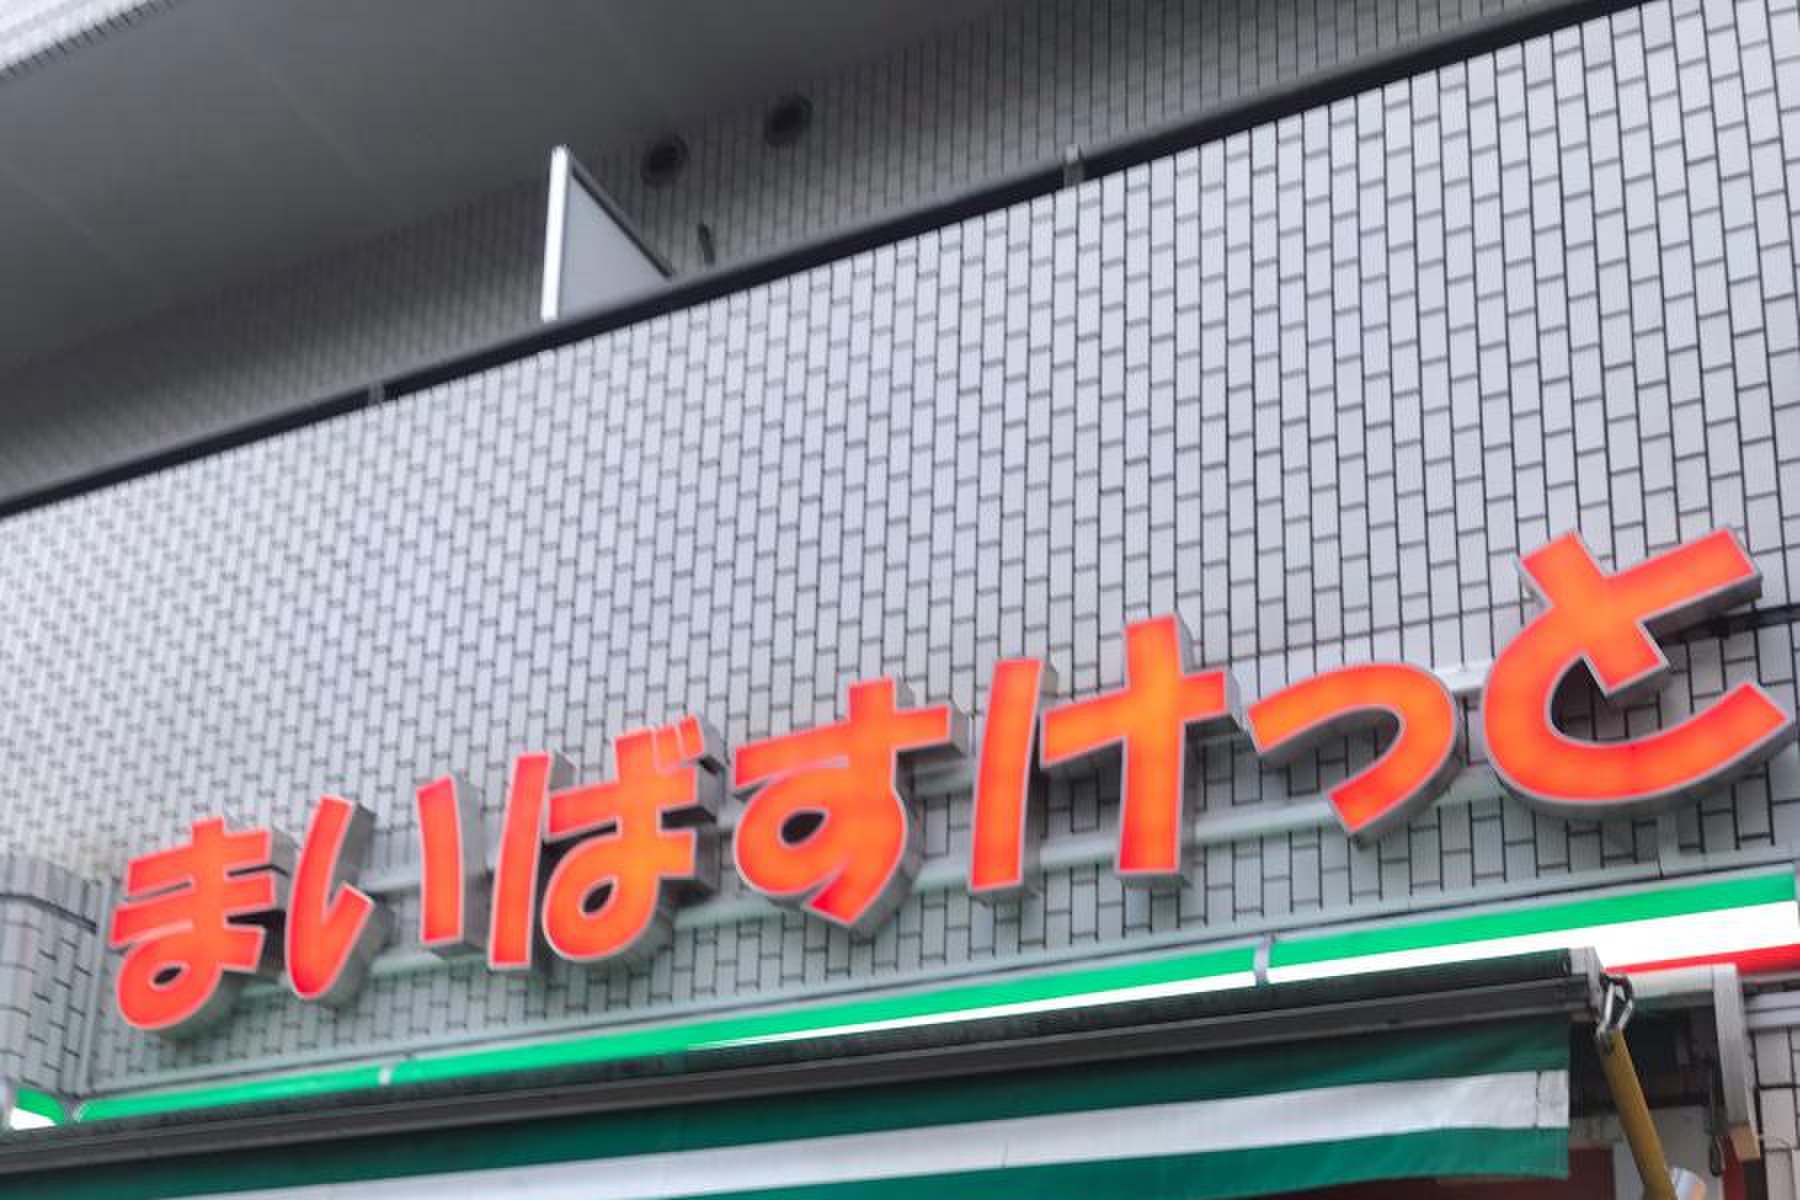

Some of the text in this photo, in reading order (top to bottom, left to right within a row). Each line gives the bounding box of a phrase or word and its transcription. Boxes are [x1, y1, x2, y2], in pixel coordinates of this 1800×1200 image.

[110, 527, 1788, 1030] まいばすけっと
